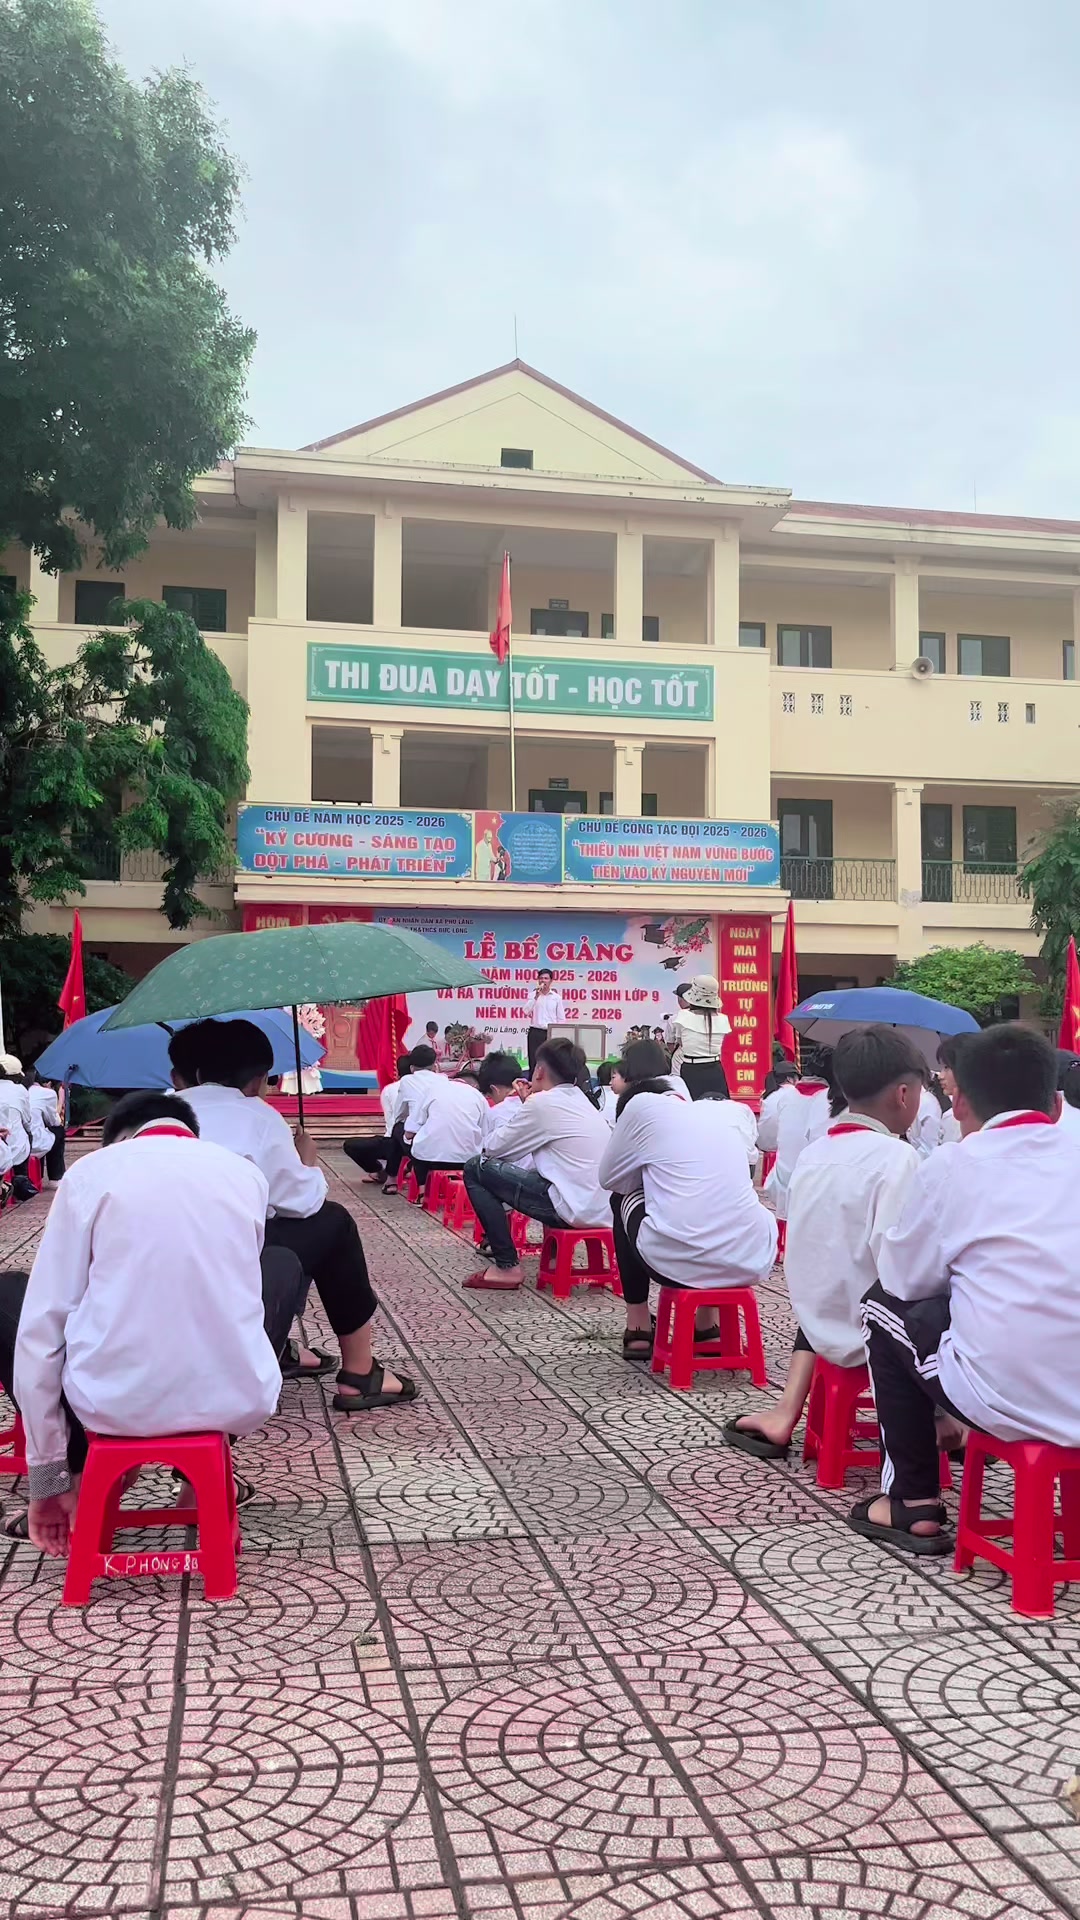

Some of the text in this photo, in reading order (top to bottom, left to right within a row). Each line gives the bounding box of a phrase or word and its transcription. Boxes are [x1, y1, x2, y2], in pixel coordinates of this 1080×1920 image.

[325, 660, 370, 690] THI
[378, 663, 438, 694] ĐUA
[447, 667, 502, 703] DẠY
[512, 664, 559, 701] TỐT
[588, 676, 642, 710] HỌC
[651, 671, 698, 708] TỐT
[265, 808, 290, 822] CHỦ
[314, 810, 342, 825] NĂM
[347, 813, 370, 827] HỌC
[375, 815, 404, 827] 2025
[416, 817, 445, 828] 2026
[579, 819, 601, 833] CHỦ
[623, 821, 653, 835] CÔNG
[657, 822, 678, 835] TÁC
[704, 826, 729, 837] 2025
[741, 827, 767, 838] 2026
[293, 832, 353, 848] CƯƠNG
[372, 833, 418, 849] SÁNG
[424, 837, 455, 853] TẠO
[618, 845, 639, 857] NHI
[644, 842, 669, 861] VIỆT
[673, 846, 701, 859] NAM
[706, 844, 737, 860] VỮNG
[741, 845, 773, 861] BƯỚC
[255, 851, 289, 870] ĐỘT
[294, 853, 329, 869] PHÁ
[347, 855, 391, 872] PHÁT
[592, 862, 620, 879] TIẾN
[624, 864, 647, 880] VÀO
[671, 866, 720, 881] NGUYÊN
[255, 914, 290, 928] HÔM
[729, 925, 761, 939] NGÀY
[464, 931, 634, 961] LỄ BẾ GIẢNG
[734, 945, 757, 957] MAI
[733, 961, 758, 974] NHÀ
[551, 969, 575, 982] 025
[588, 970, 618, 982] 2026
[722, 978, 768, 992] TRƯỜNG
[457, 987, 474, 999] RA
[478, 985, 528, 1000] TRƯỜNG
[562, 988, 586, 1003] HỌC
[591, 989, 621, 1001] SINH
[625, 988, 648, 1002] LỚP
[652, 990, 660, 1002] 9
[475, 1004, 507, 1019] NIÊN
[592, 1008, 622, 1020] 2026
[738, 997, 754, 1012] TỰ
[733, 1014, 757, 1028] HÀO
[733, 1049, 758, 1063] CÁC
[736, 1069, 755, 1081] EM
